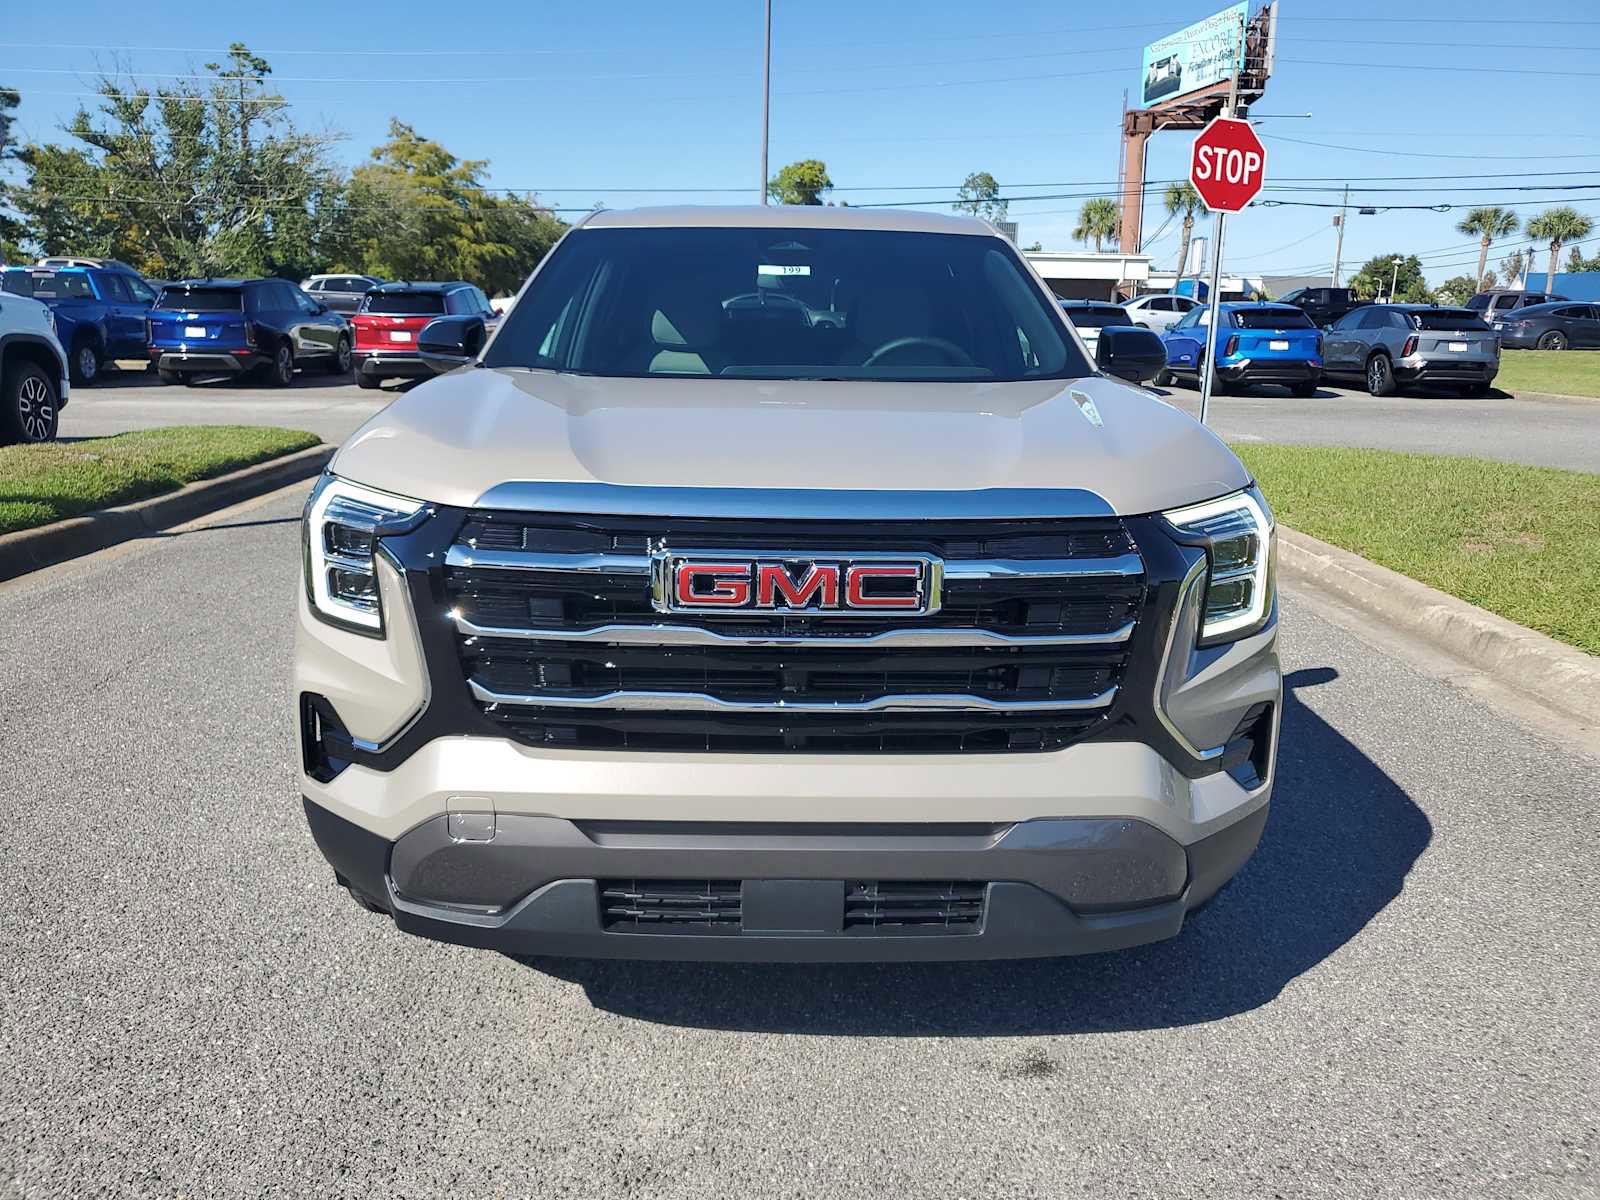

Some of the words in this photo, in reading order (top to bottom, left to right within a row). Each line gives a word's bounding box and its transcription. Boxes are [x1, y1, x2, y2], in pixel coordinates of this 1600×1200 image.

[1192, 28, 1233, 58] ENCORE
[1195, 144, 1261, 185] STOP
[677, 562, 919, 608] GMC
